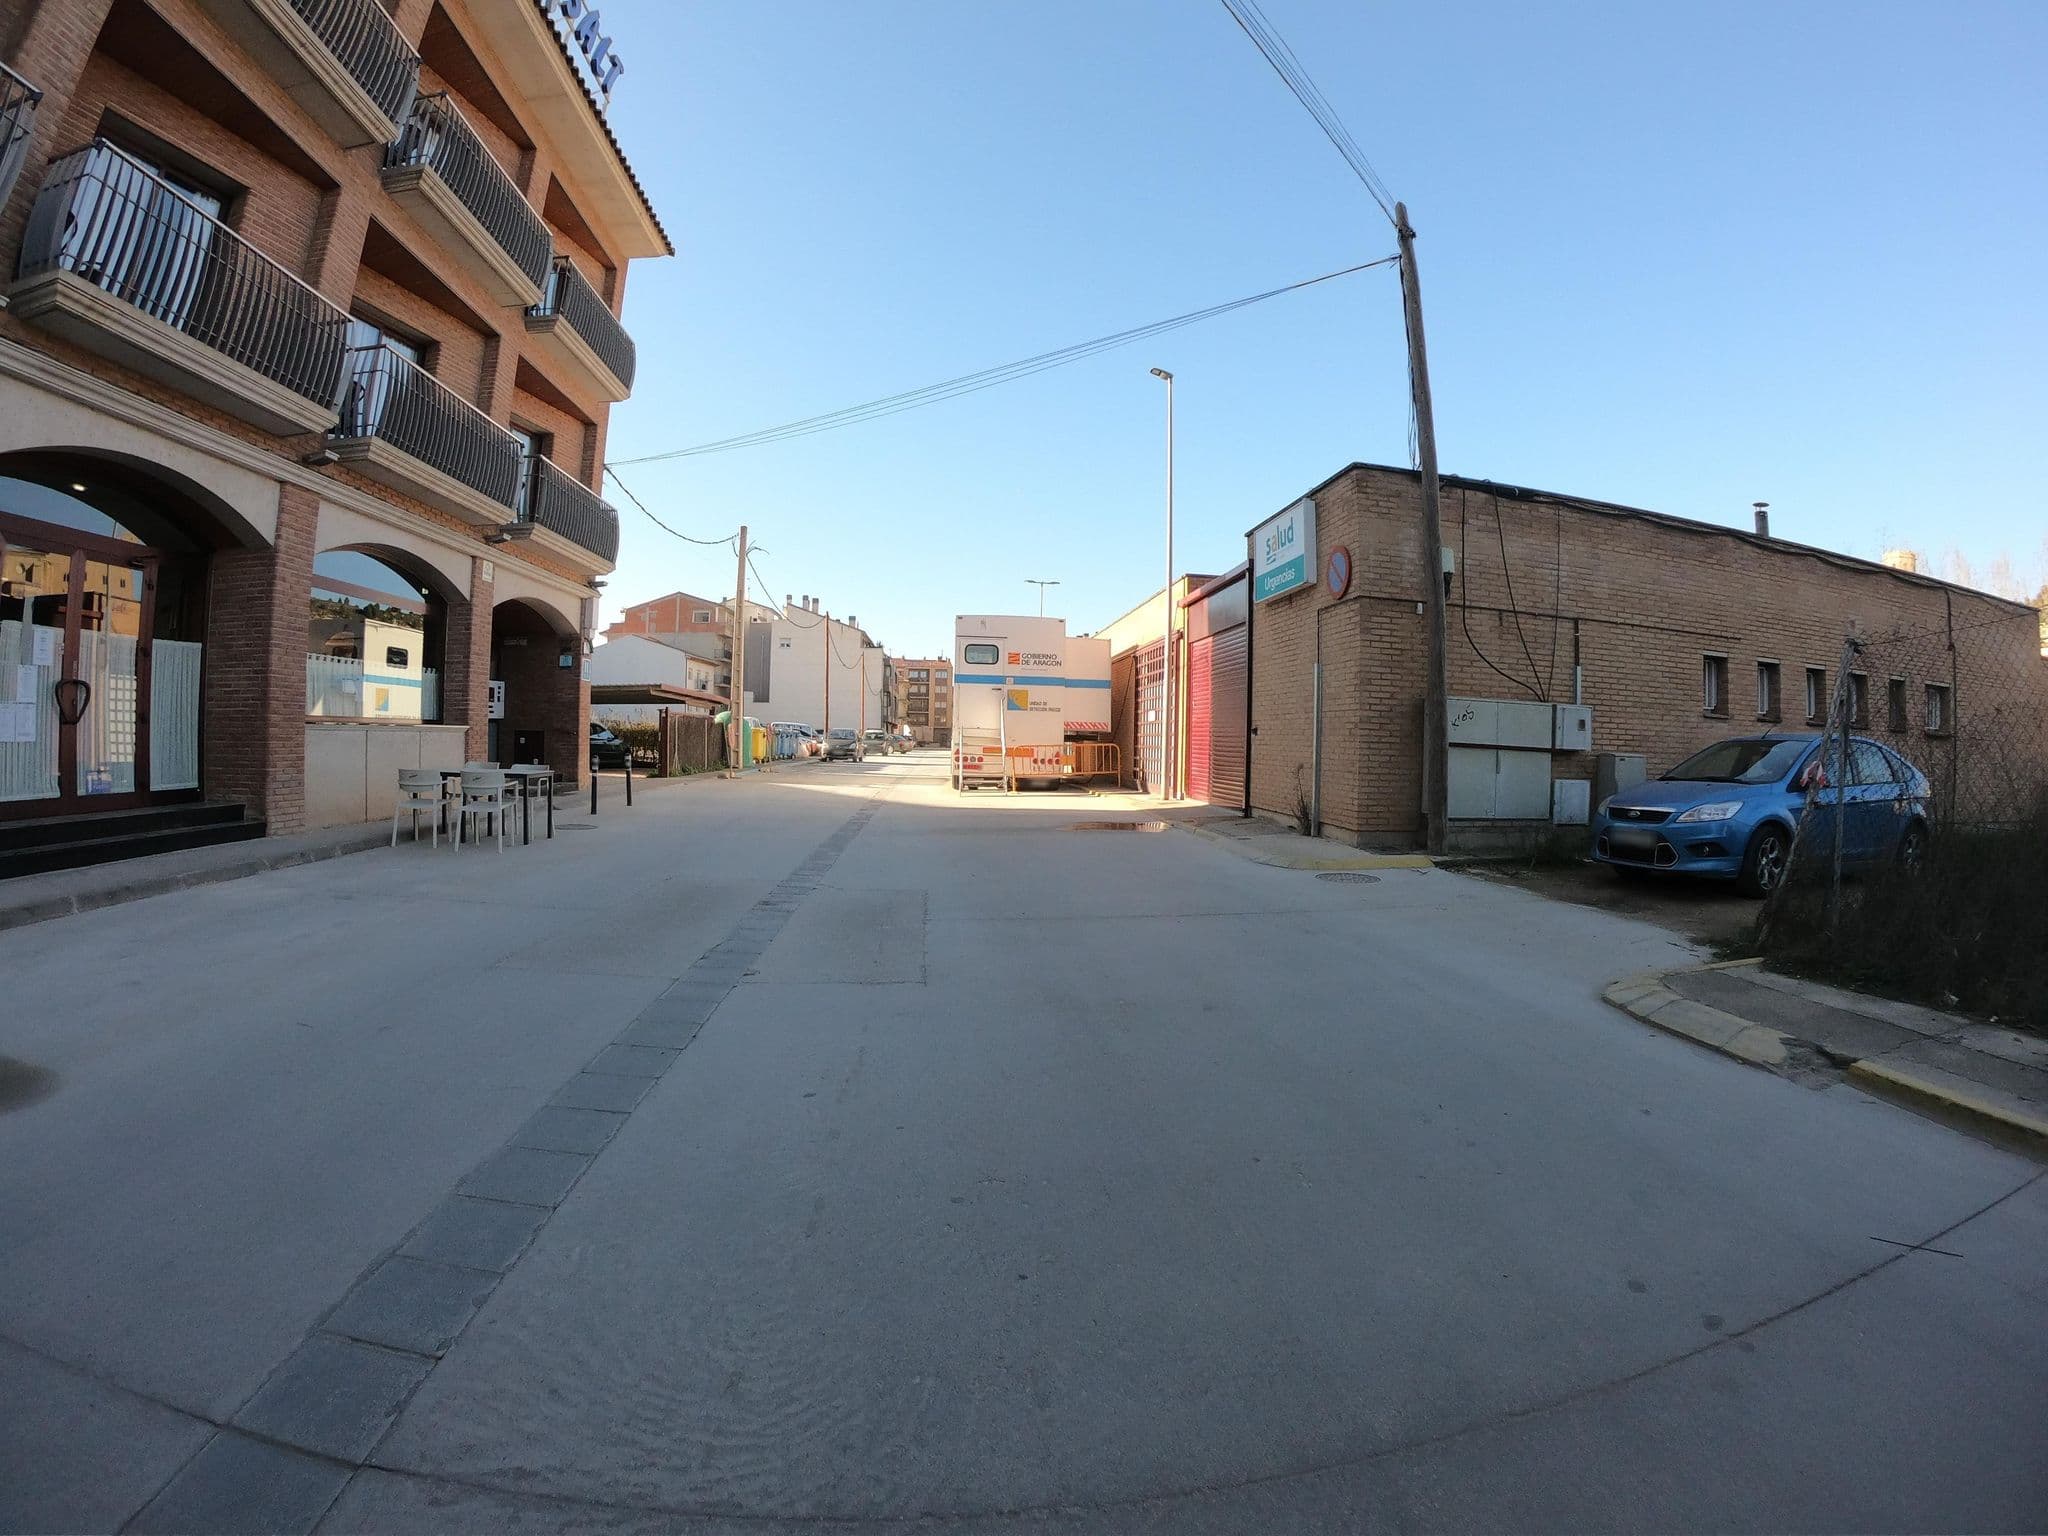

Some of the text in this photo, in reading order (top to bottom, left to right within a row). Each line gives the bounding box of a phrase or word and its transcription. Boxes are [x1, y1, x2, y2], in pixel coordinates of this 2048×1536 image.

[1266, 517, 1294, 555] salud
[1264, 568, 1295, 590] Urgencias
[1021, 652, 1057, 660] GOBIERNO
